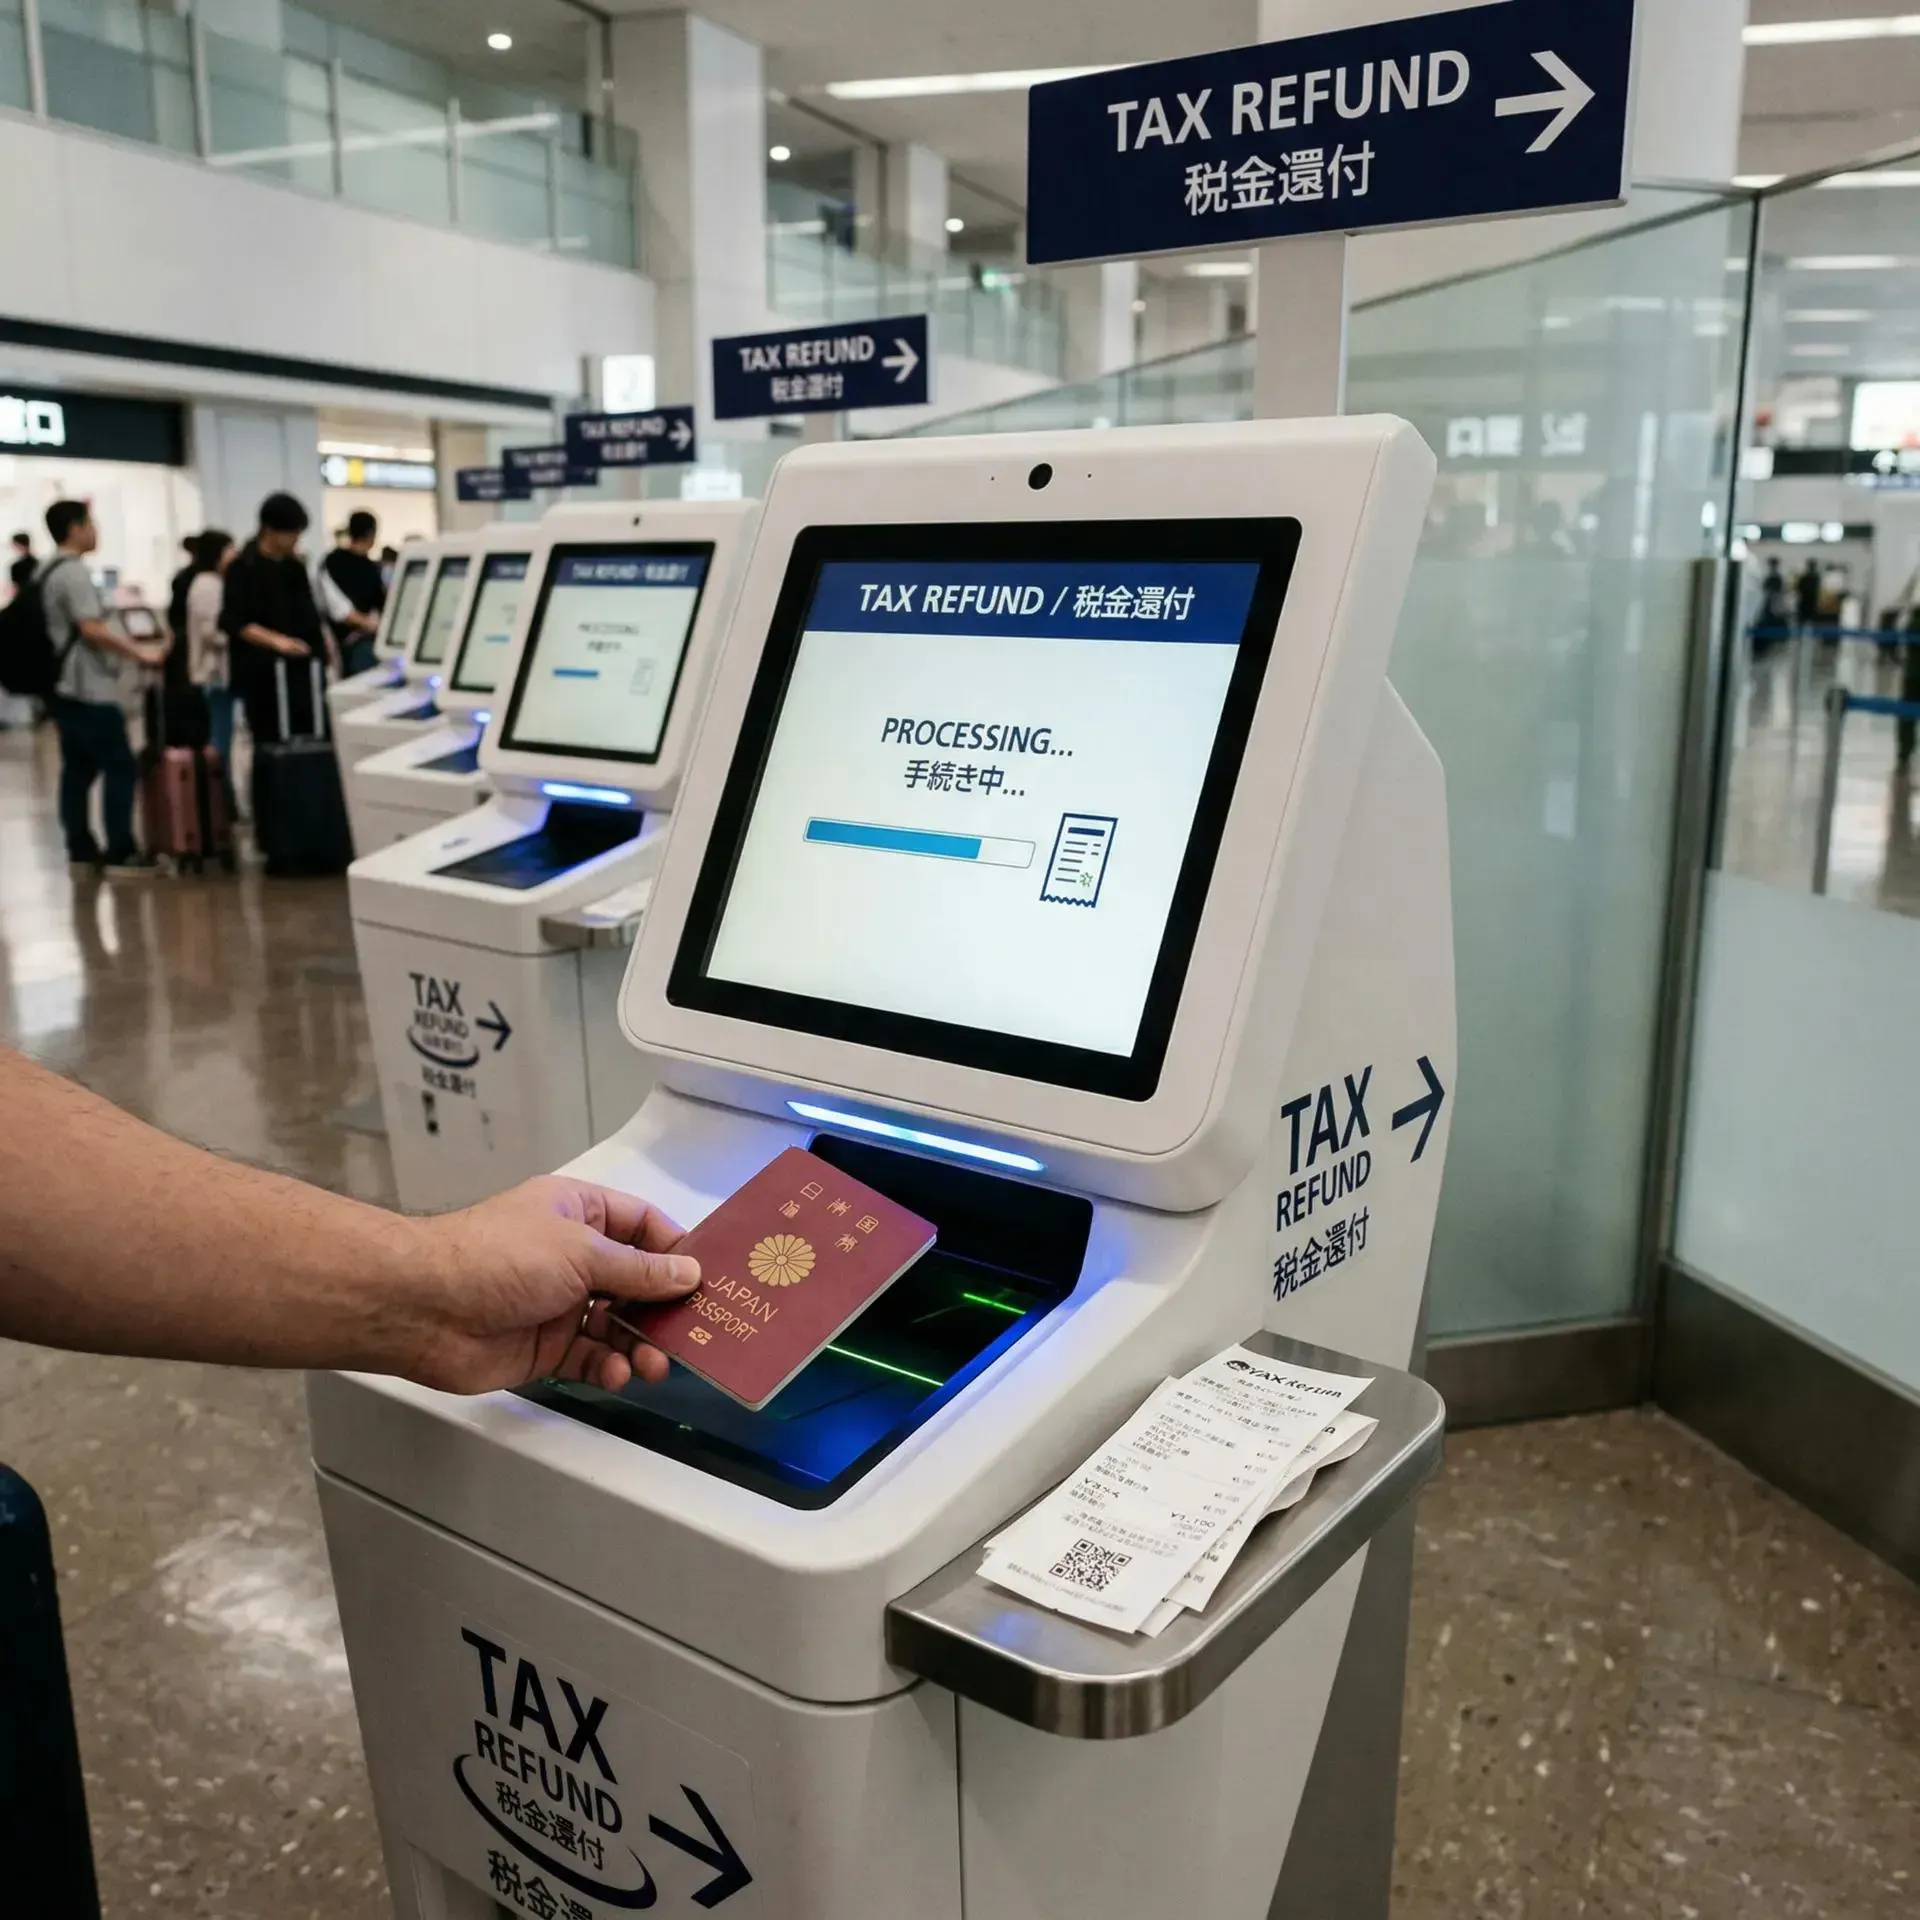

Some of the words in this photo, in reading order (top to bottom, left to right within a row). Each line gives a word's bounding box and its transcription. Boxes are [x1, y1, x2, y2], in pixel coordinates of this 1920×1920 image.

[1107, 88, 1213, 152] TAX
[1231, 49, 1470, 135] REFUND
[1184, 140, 1375, 216] 税金還付
[739, 345, 781, 372] TAX
[786, 335, 875, 368] REFUND
[859, 584, 919, 613] TAX
[922, 586, 1044, 616] REFUND
[1050, 586, 1068, 616] /
[1073, 584, 1196, 621] 税金還付
[881, 717, 1074, 757] PROCESSING...
[408, 971, 463, 1017] TAX
[1281, 1064, 1373, 1175] TAX
[1276, 1150, 1371, 1232] REFUND
[1273, 1206, 1370, 1302] 税金還付
[685, 1291, 758, 1343] PASSPORT
[708, 1275, 779, 1323] JAPAN
[461, 1626, 618, 1785] TAX
[474, 1718, 622, 1834] REFUND
[495, 1781, 604, 1871] 税金還付
